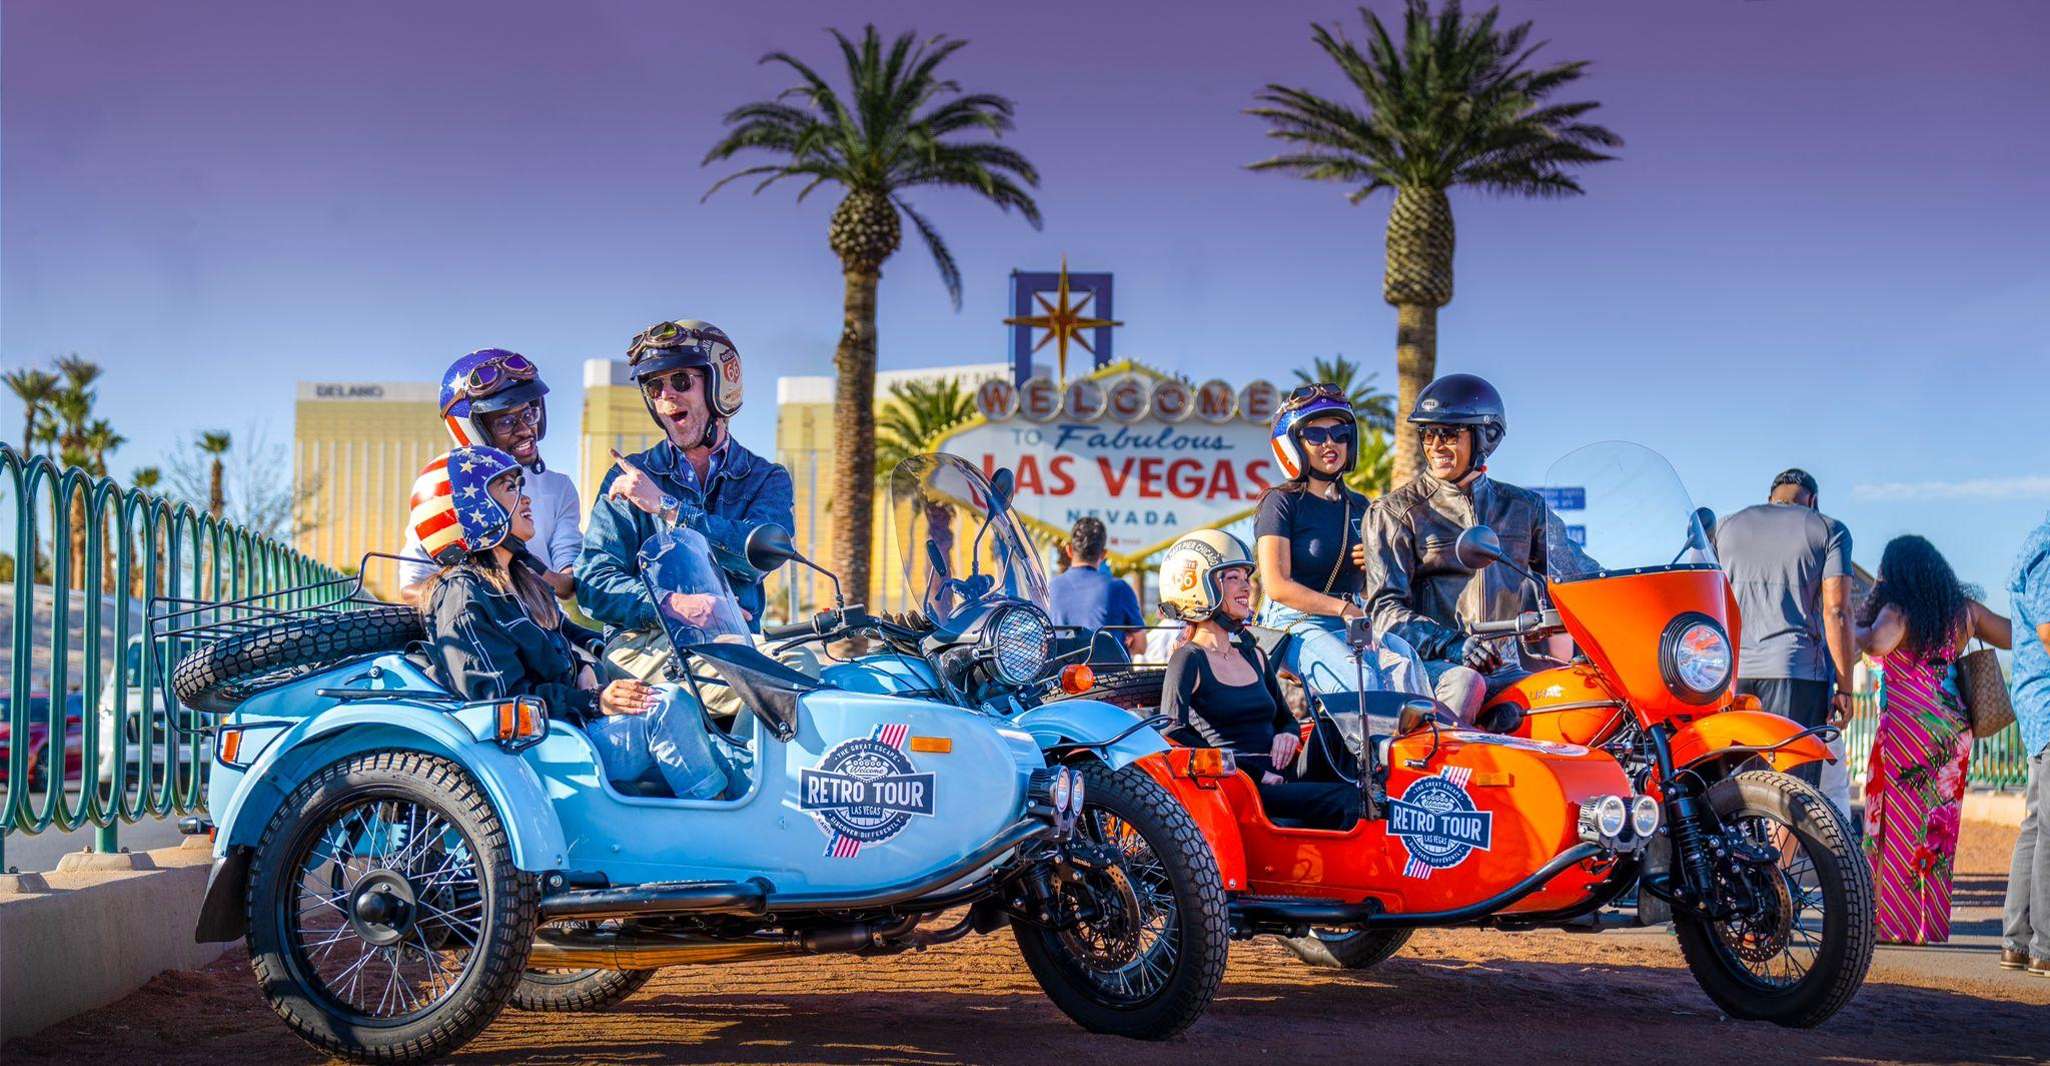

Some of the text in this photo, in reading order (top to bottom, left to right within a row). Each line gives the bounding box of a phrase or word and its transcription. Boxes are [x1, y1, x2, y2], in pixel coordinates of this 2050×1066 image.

[727, 361, 740, 381] 66
[316, 383, 384, 398] DELANO
[981, 383, 1273, 416] WELCOME
[1010, 424, 1234, 450] TO Fabulous
[1097, 456, 1272, 501] VEGAS
[1066, 509, 1179, 527] NEVADA
[837, 744, 899, 761] THE GREAT ESCAPE
[849, 765, 884, 774] Welcome
[807, 775, 924, 808] RETRO TOUR
[851, 805, 881, 816] LAS VEGAS
[830, 816, 859, 837] DISCOVER
[860, 818, 902, 838] DIFFERENTLY
[1393, 805, 1482, 842] RETRO TOUR
[1423, 834, 1448, 845] LAS VEGAS
